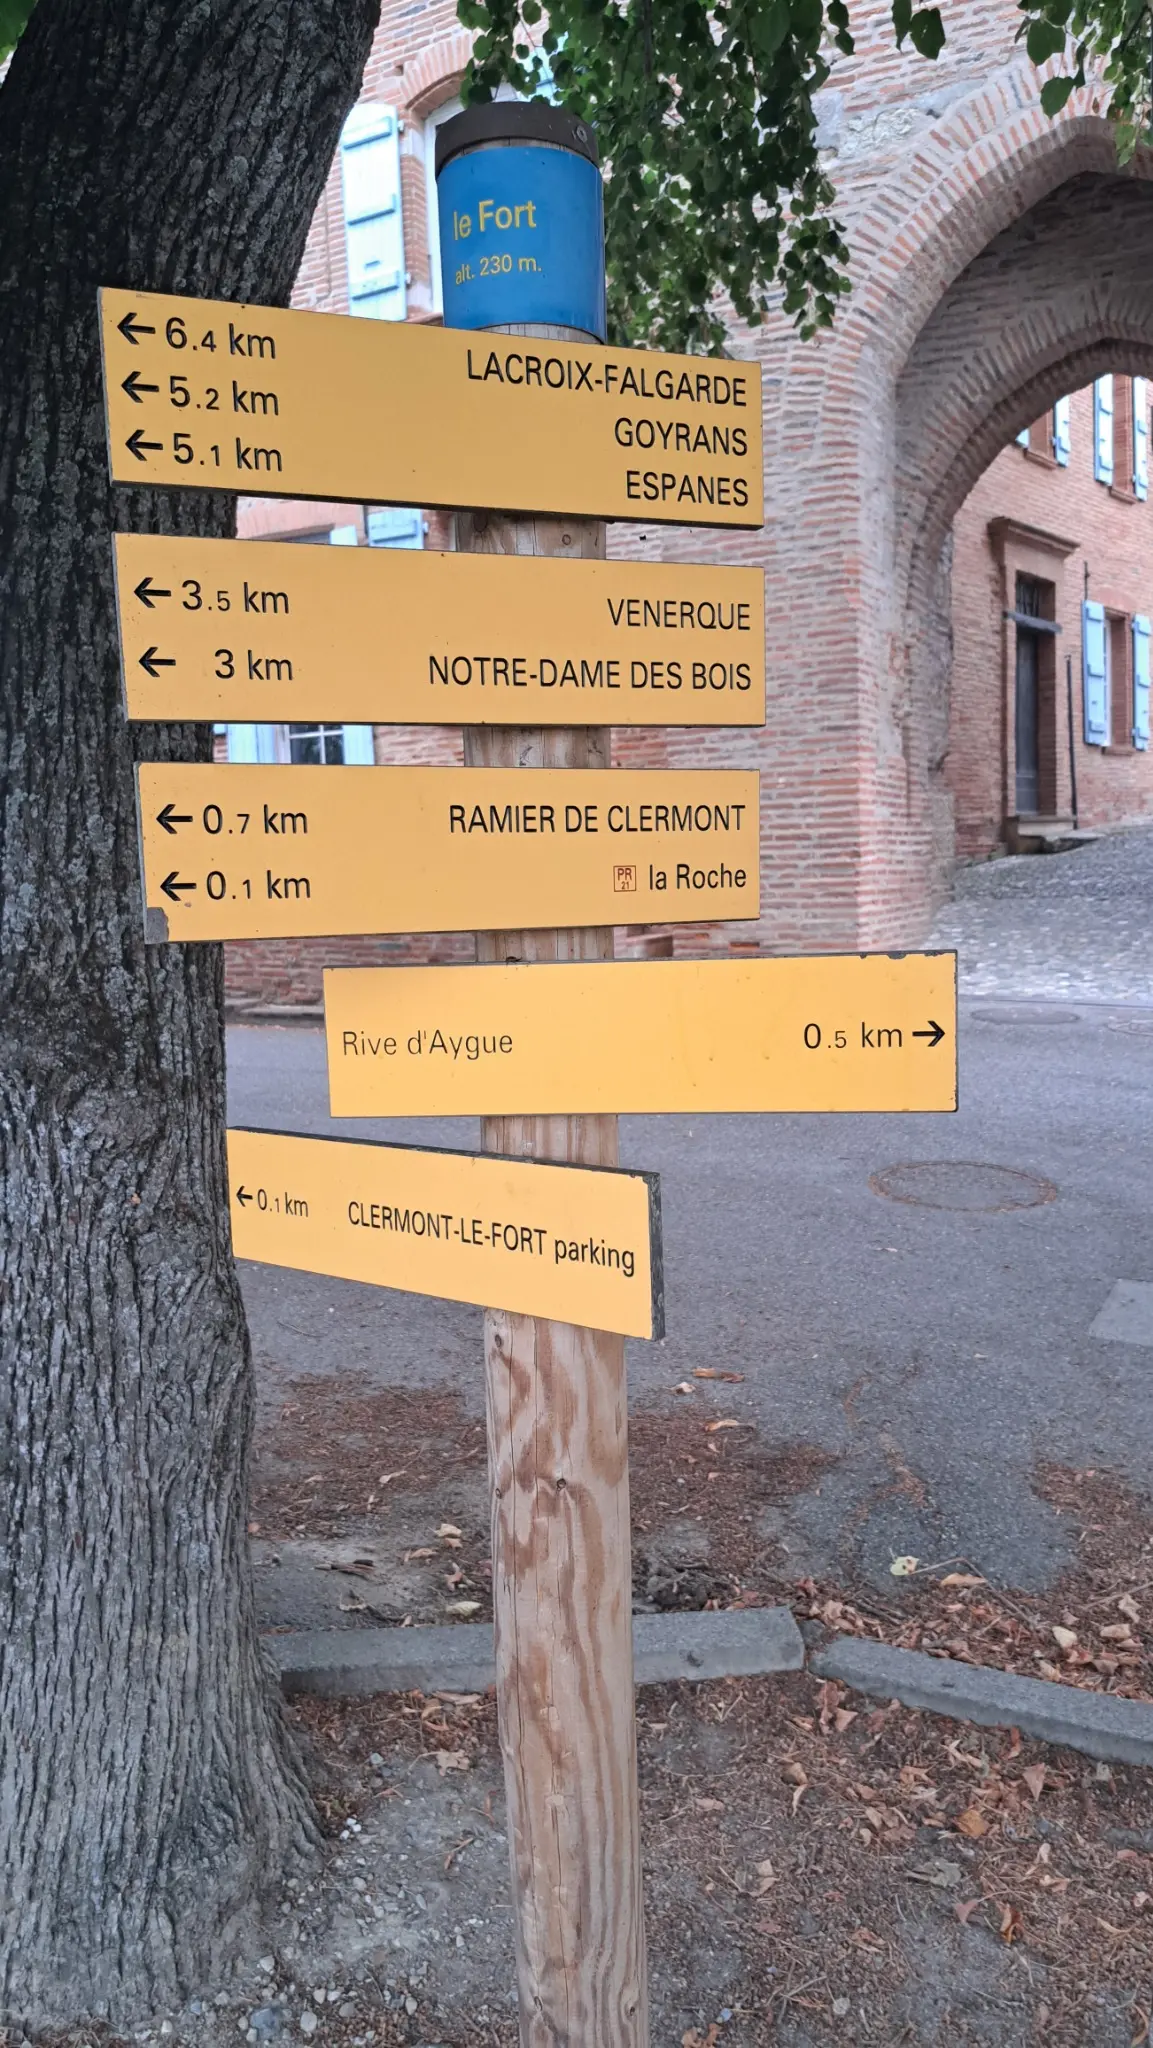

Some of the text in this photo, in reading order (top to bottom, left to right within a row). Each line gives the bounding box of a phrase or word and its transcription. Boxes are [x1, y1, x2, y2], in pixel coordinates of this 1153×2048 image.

[453, 199, 537, 241] le Fort
[455, 254, 542, 285] alt. 230 m.
[165, 316, 276, 360] 6.4 km
[467, 348, 747, 407] LACROIX-FALGARDE
[169, 375, 279, 416] 5.2 km
[173, 432, 283, 472] 5.1 km
[614, 417, 748, 457] GOYRANS
[626, 470, 749, 507] ESPANES
[181, 579, 289, 614] 3.5 km
[606, 598, 751, 631] VENERQUE
[214, 648, 293, 681] 3 km
[429, 655, 752, 691] NOTRE-DAME DES BOIS
[202, 803, 308, 835] 0.7 km
[449, 804, 746, 834] RAMIER DE CLERMONT
[206, 869, 311, 901] 0.1 km
[617, 867, 633, 881] PR
[620, 881, 631, 890] 21
[649, 862, 747, 891] la Roche
[342, 1029, 513, 1061] Rive d'Aygue
[803, 1021, 903, 1050] 0.5 km
[257, 1188, 309, 1218] 0.1 km
[348, 1201, 635, 1278] CLERMONT-LE-FORT parking
